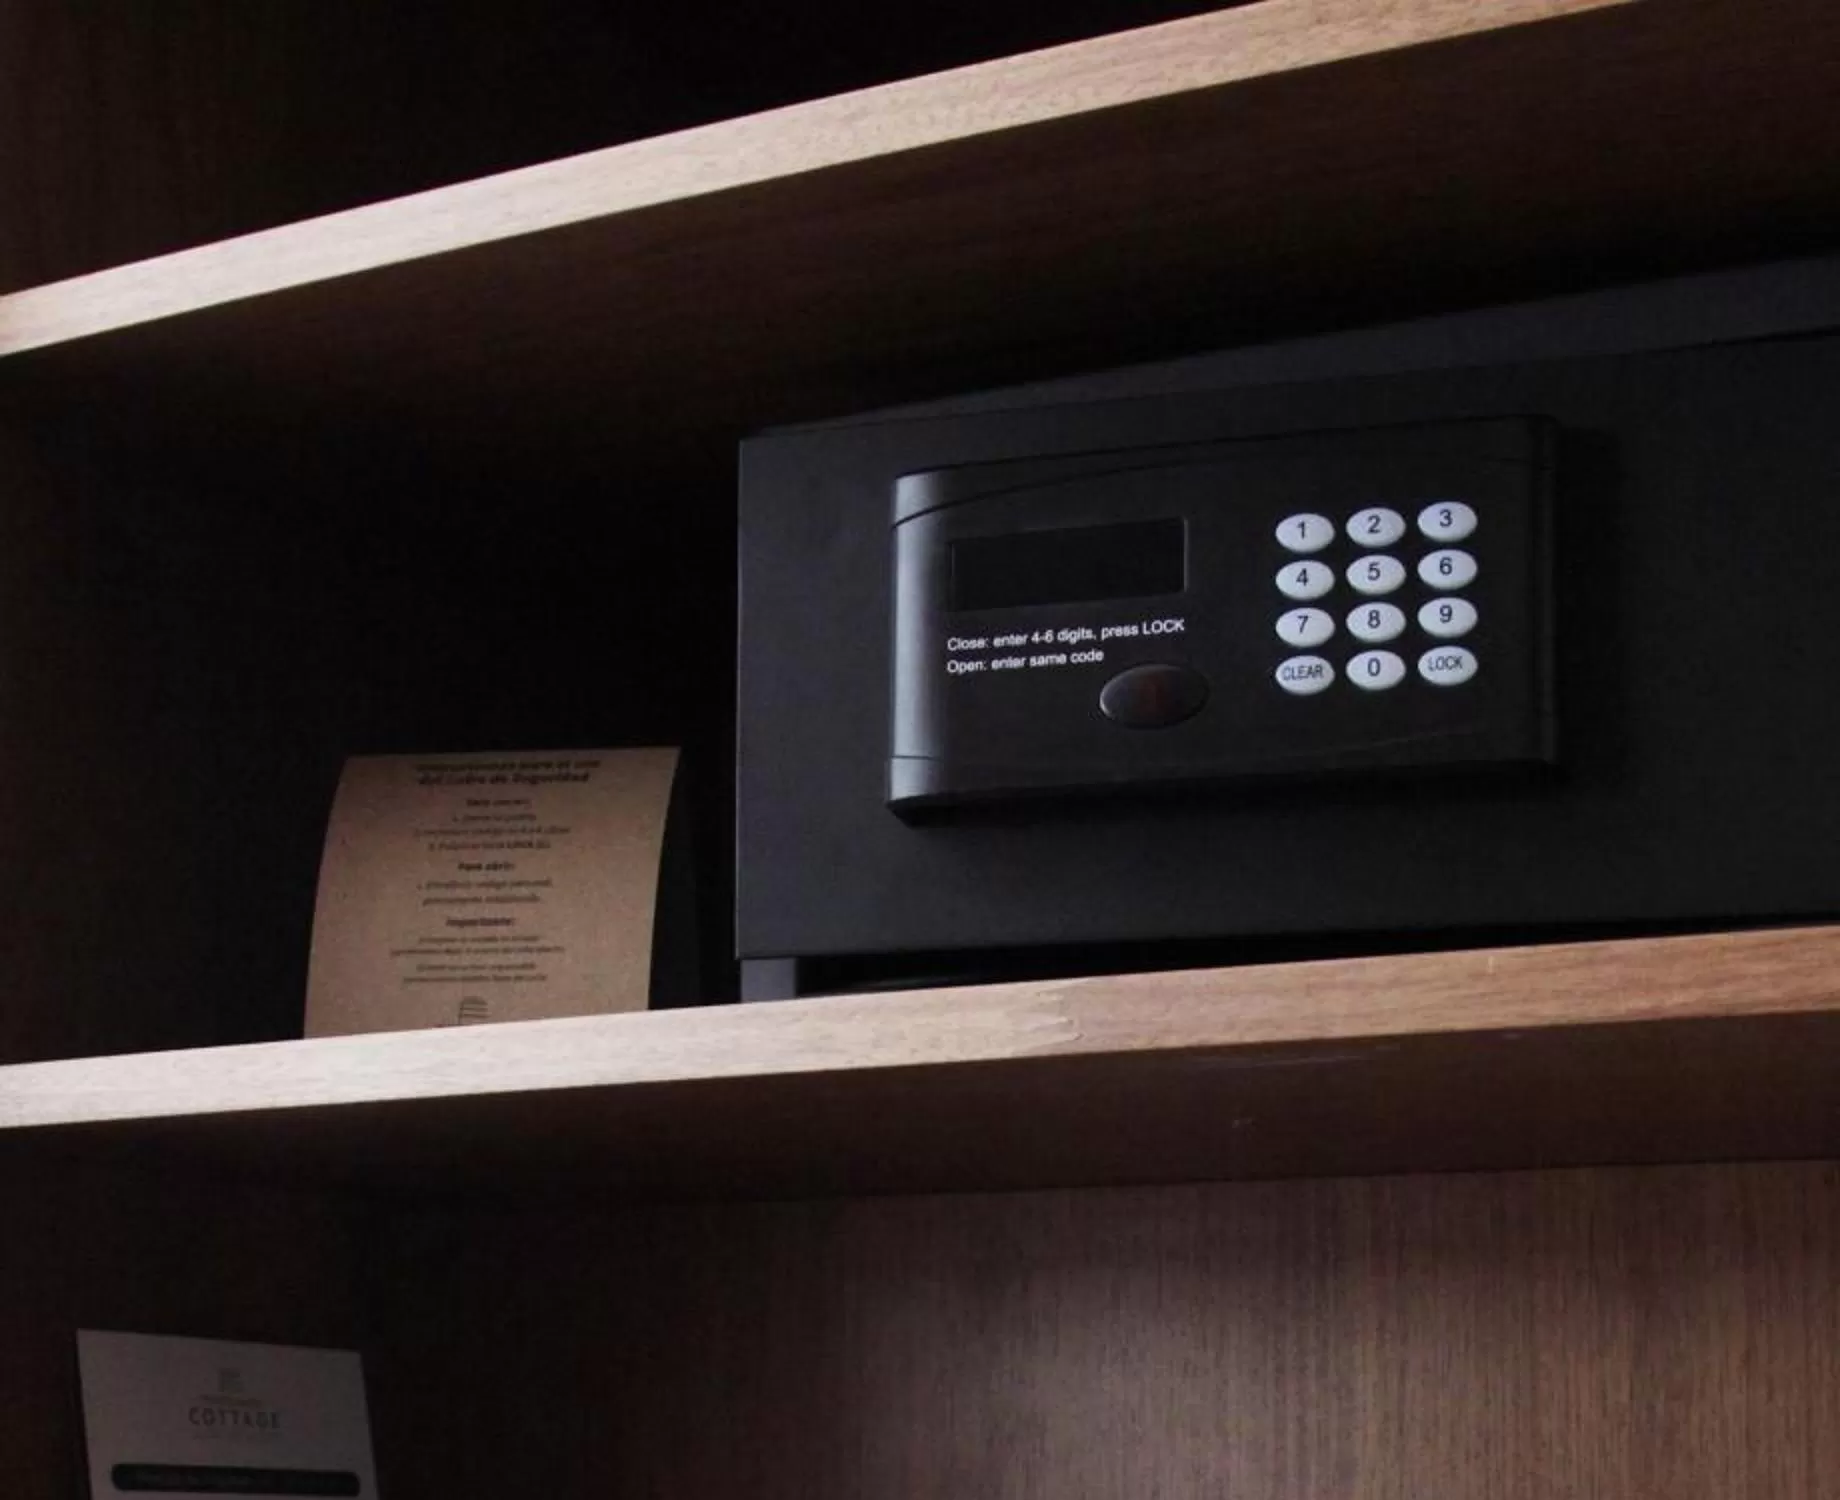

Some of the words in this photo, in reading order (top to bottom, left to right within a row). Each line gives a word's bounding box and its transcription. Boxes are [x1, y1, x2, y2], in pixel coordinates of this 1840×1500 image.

[1366, 514, 1381, 534] 2
[1438, 508, 1453, 528] 3
[1297, 521, 1306, 540] 1
[1367, 561, 1381, 581] 5
[1438, 556, 1453, 576] 6
[1295, 567, 1308, 587] 4
[1296, 614, 1309, 634] 7
[1366, 608, 1381, 629] 8
[1438, 604, 1453, 624] 9
[947, 636, 989, 651] Close:
[992, 634, 1027, 649] enter
[1030, 629, 1055, 644] 4-6
[1057, 626, 1097, 645] digits,
[1100, 623, 1139, 641] press
[1142, 618, 1185, 636] LOCK
[946, 658, 988, 676] Open:
[991, 656, 1026, 671] enter
[1029, 653, 1068, 668] same
[1070, 648, 1104, 663] code
[1282, 663, 1324, 681] CLEAR
[1366, 657, 1381, 677] 0
[1426, 655, 1463, 672] LOCK
[188, 1406, 281, 1429] COTTAGE
